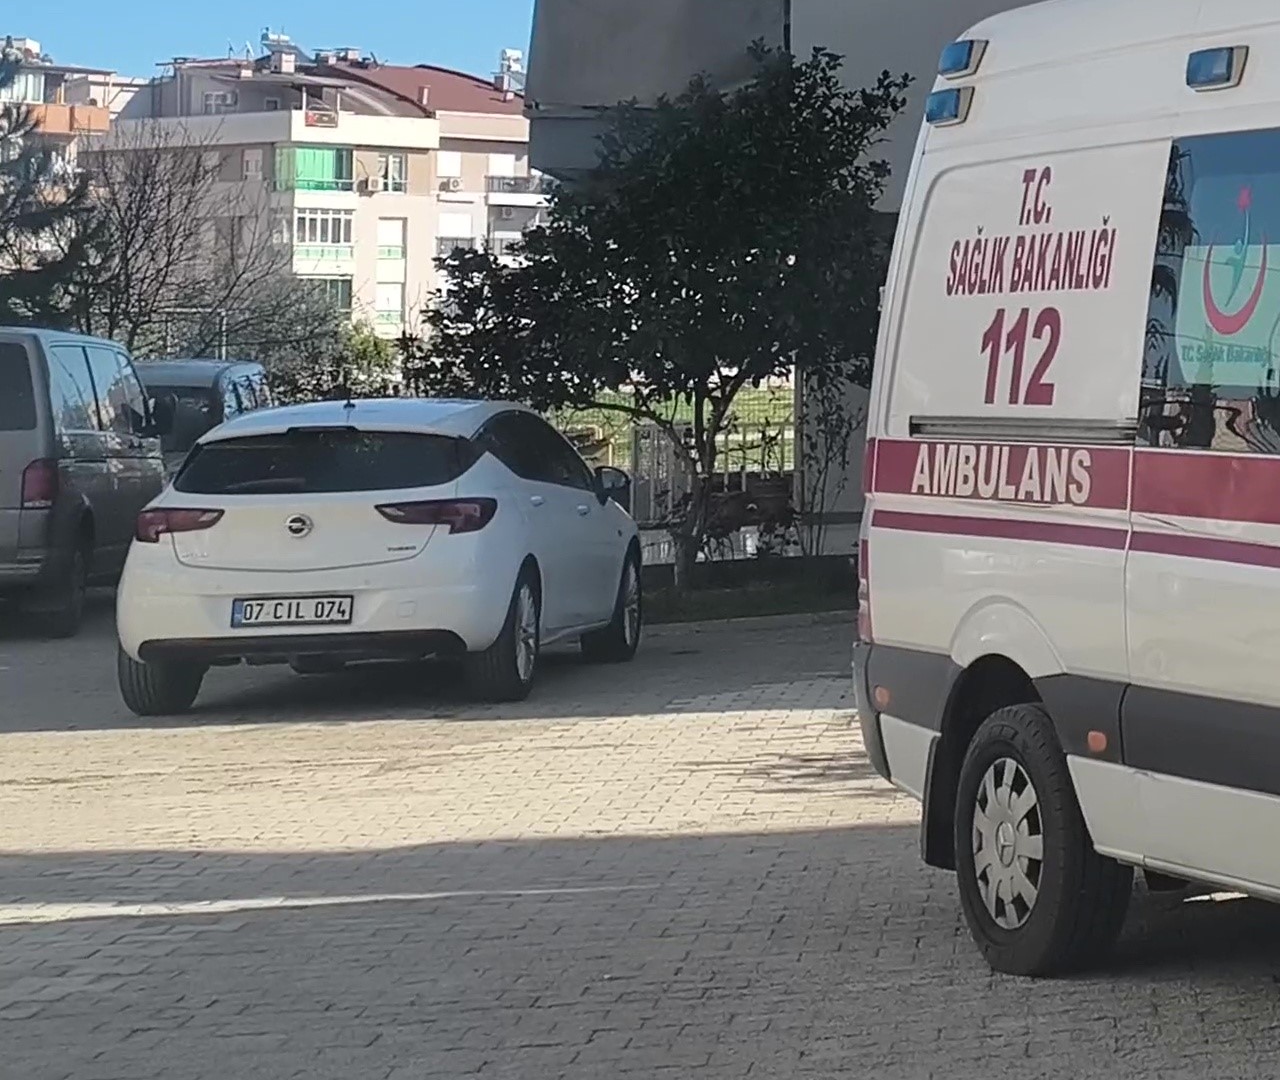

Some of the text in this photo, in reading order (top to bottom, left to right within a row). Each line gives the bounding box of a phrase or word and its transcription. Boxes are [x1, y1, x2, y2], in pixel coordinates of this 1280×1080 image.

[1019, 166, 1052, 226] T.C.
[946, 215, 1117, 296] SAĞLIK BAKANLIĞI
[980, 306, 1062, 406] 112
[911, 443, 1092, 504] AMBULANS
[243, 600, 346, 621] 07 CIL 074
